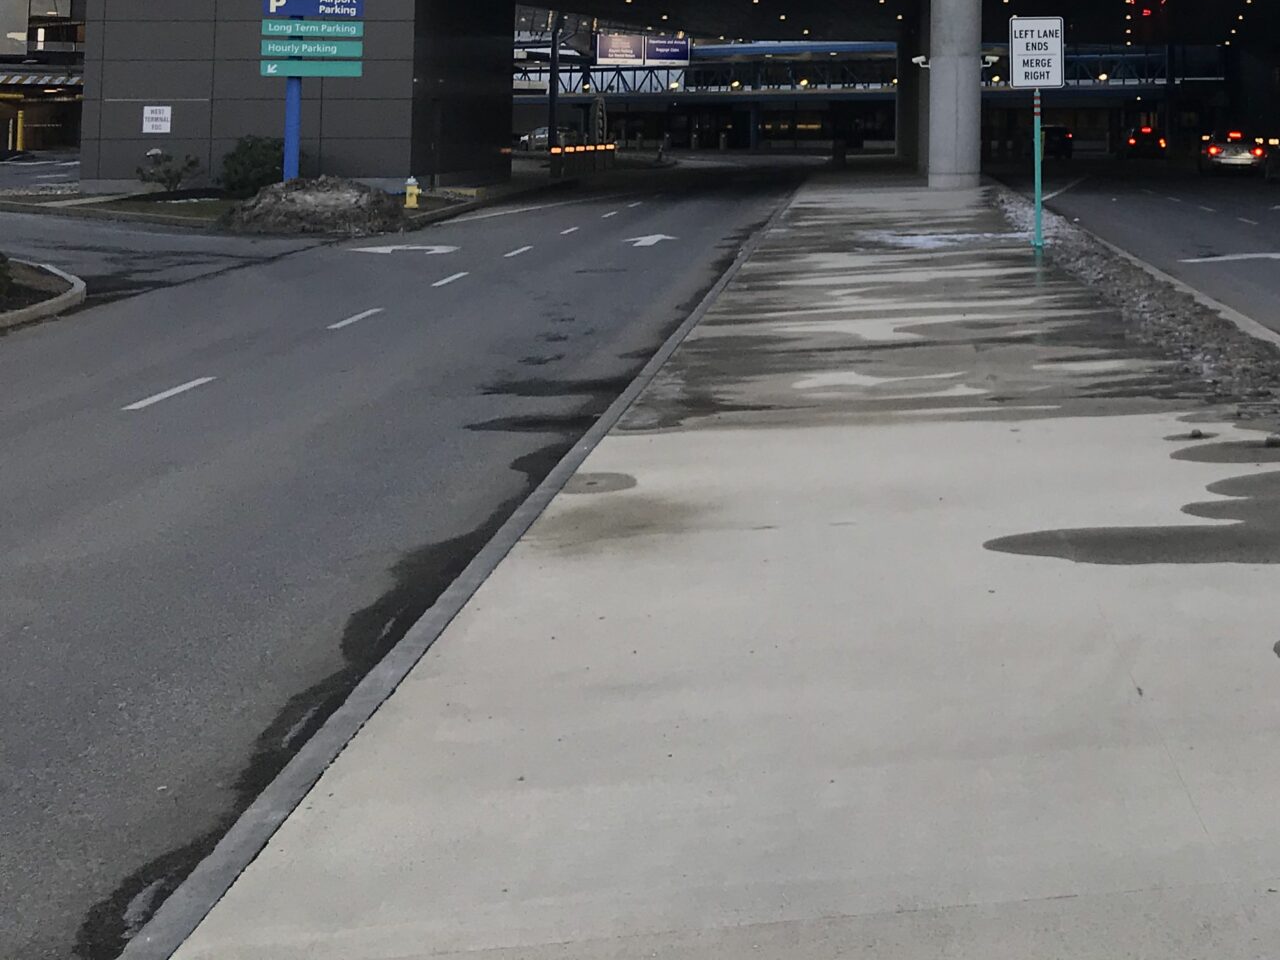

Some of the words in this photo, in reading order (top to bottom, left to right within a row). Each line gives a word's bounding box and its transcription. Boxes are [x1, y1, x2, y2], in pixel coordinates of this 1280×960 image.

[319, 5, 357, 17] Parking
[268, 23, 292, 33] Long
[295, 23, 319, 32] Term
[321, 24, 356, 35] Parking
[1014, 29, 1035, 39] LEFT
[1037, 29, 1060, 39] LANE
[268, 43, 300, 53] Hourly
[301, 44, 337, 54] Parking
[1025, 42, 1049, 51] ENDS
[1022, 58, 1052, 68] MERGE
[1024, 71, 1051, 80] RIGHT
